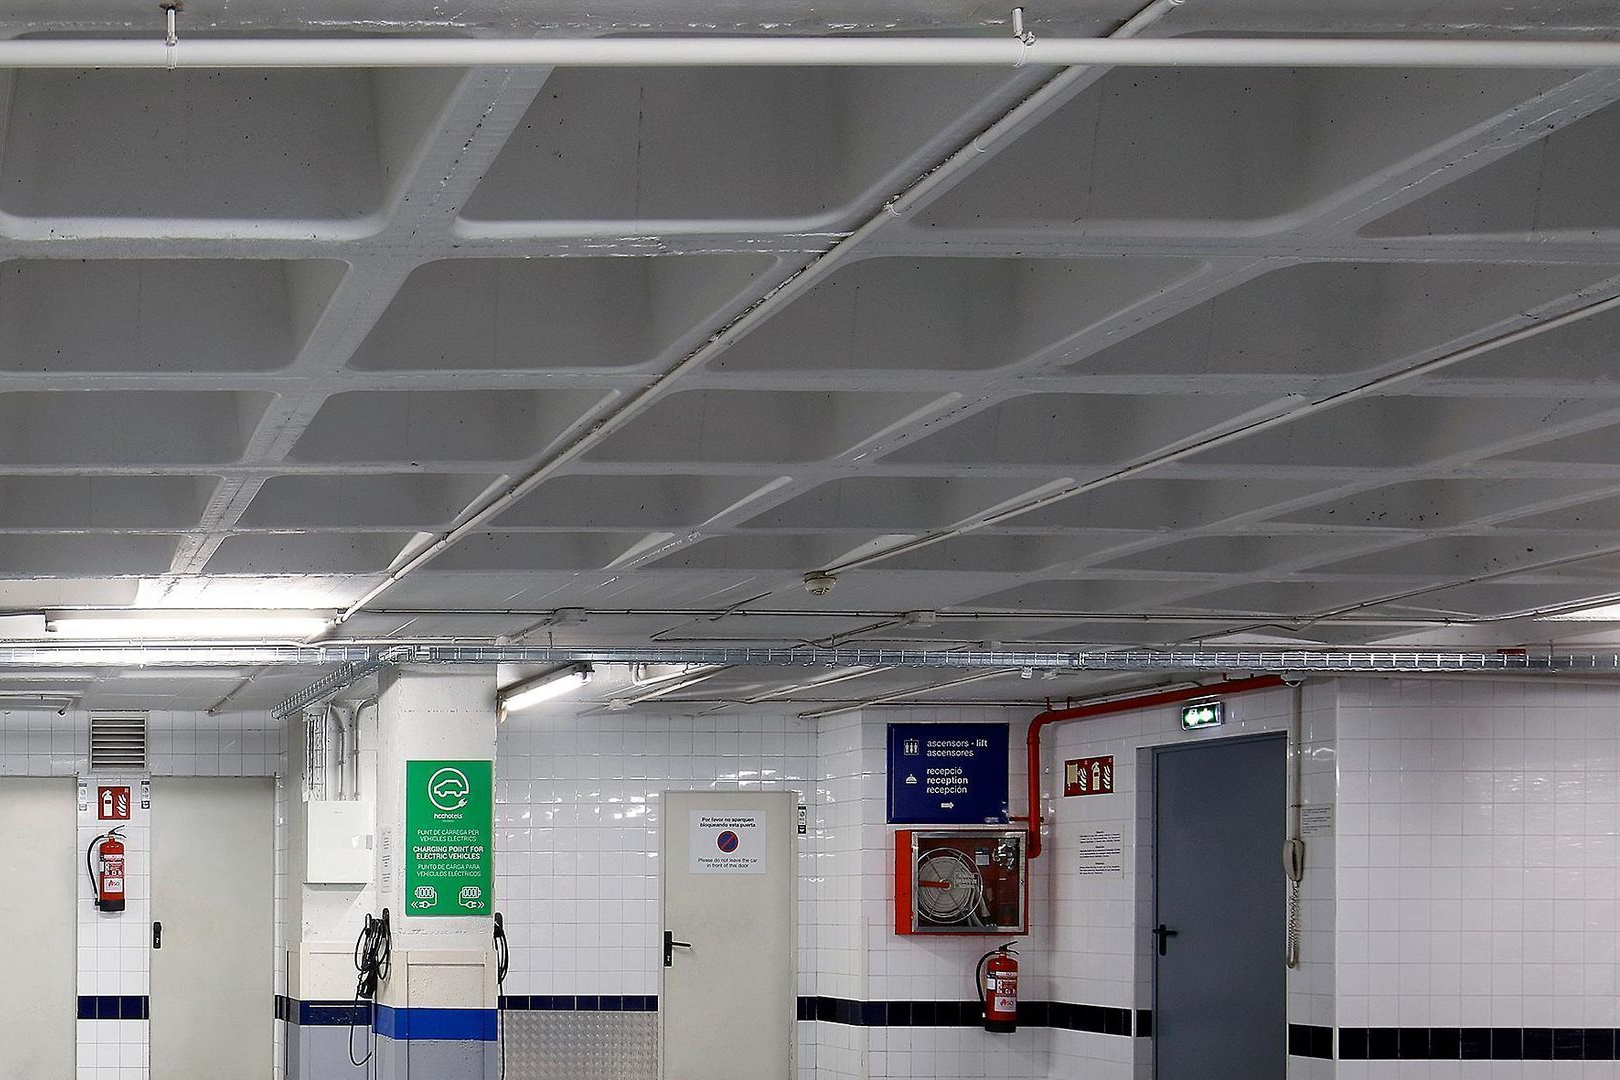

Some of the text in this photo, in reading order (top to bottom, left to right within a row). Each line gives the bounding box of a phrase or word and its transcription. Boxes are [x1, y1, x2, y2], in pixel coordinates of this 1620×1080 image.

[976, 739, 988, 747] lift
[927, 766, 963, 776] recepció
[927, 776, 969, 786] reception
[927, 785, 968, 795] recepción
[412, 845, 484, 853] CHARGING POINT FOR
[416, 852, 481, 860] ELECTRIC VEHICLES
